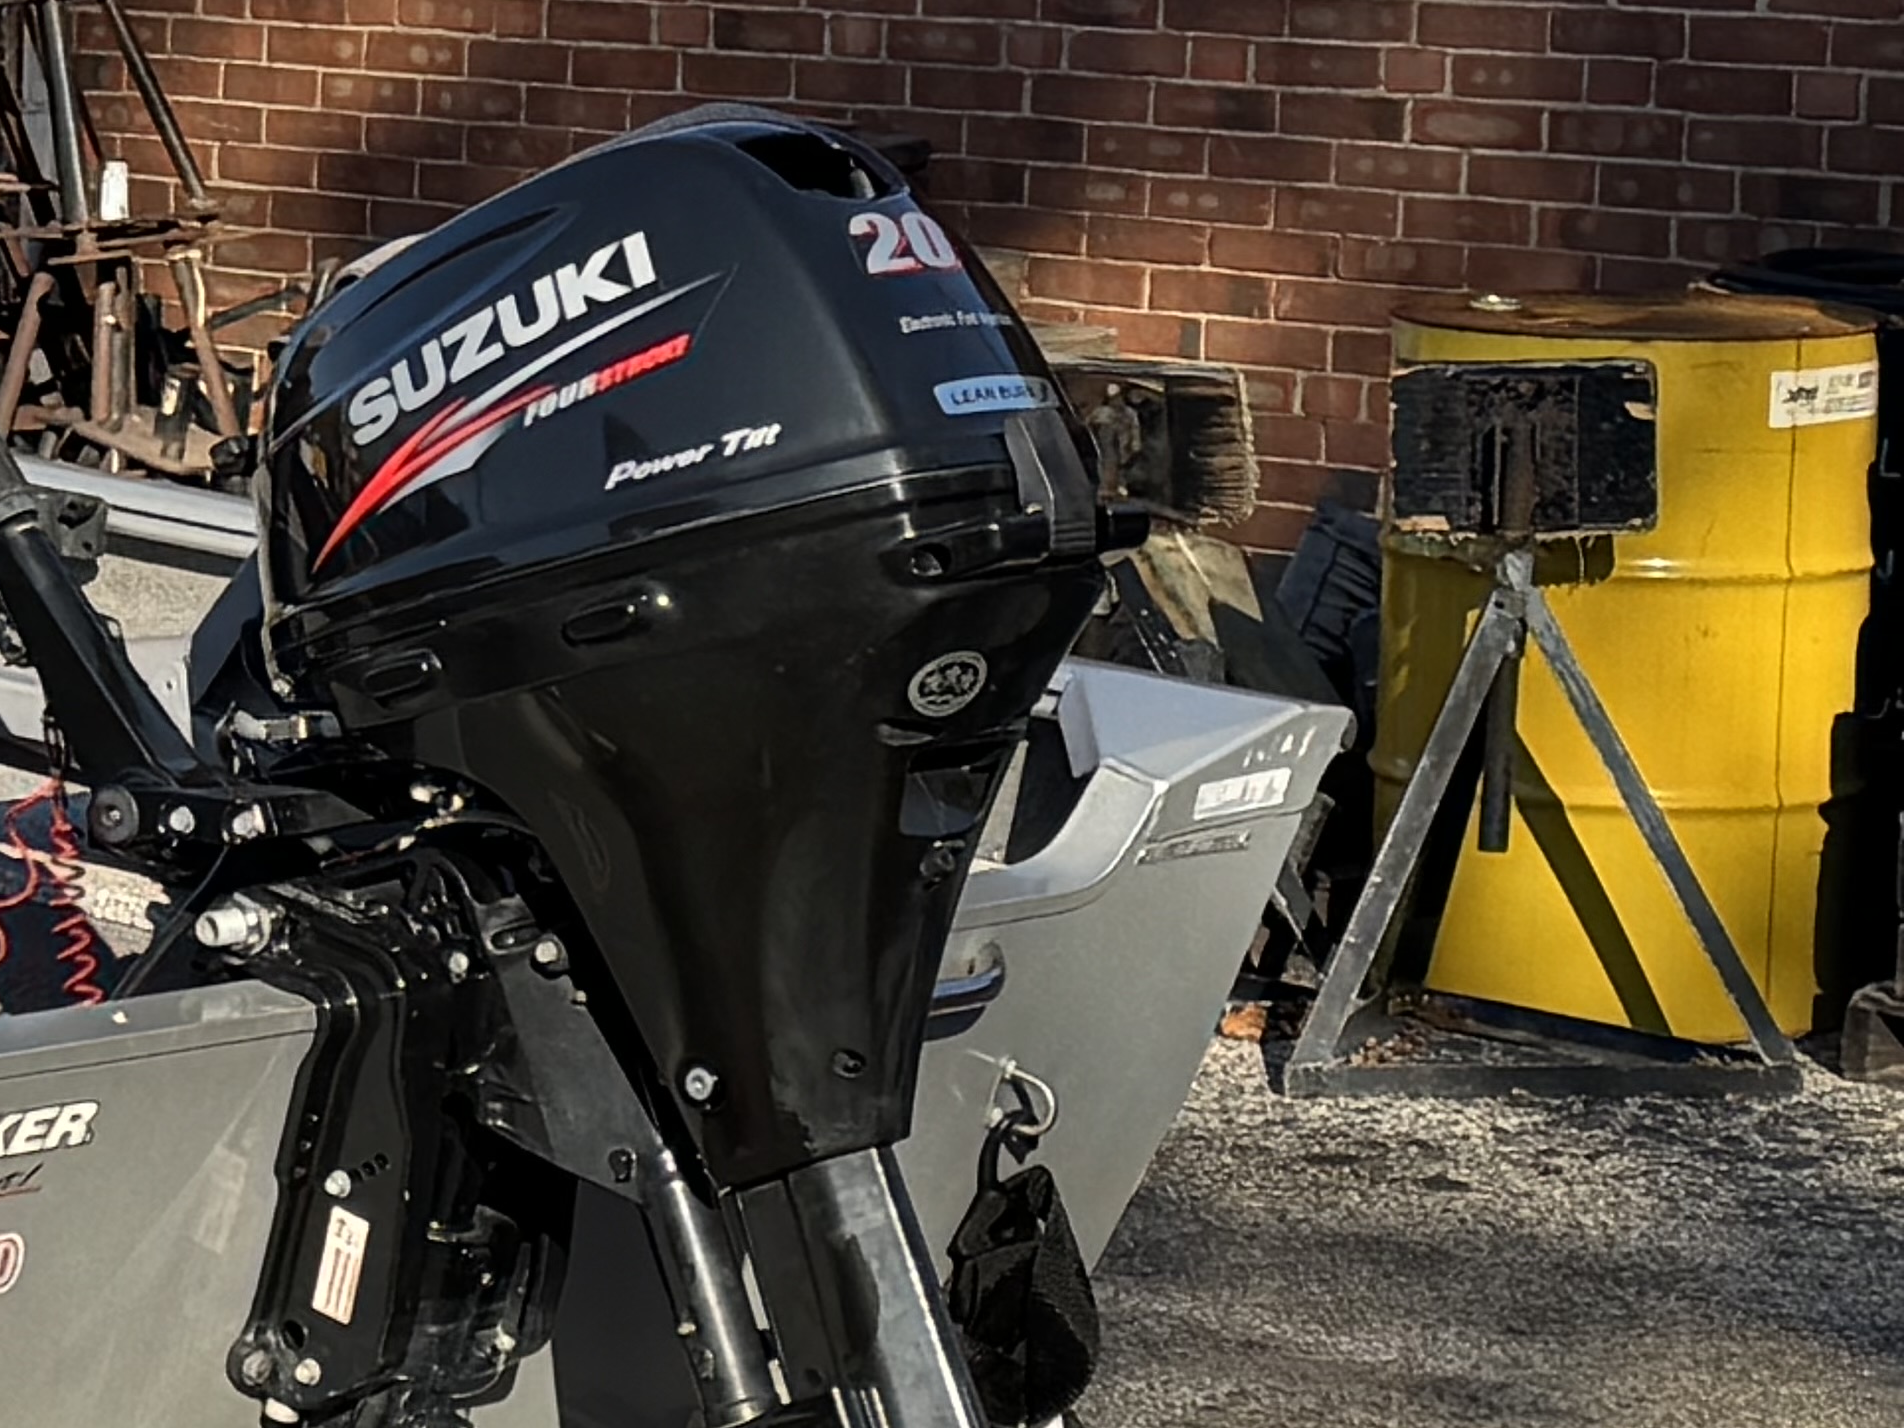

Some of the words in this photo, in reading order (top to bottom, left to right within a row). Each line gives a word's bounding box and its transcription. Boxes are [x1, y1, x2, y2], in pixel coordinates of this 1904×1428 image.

[848, 211, 962, 277] 20
[347, 230, 657, 448] SUZUKI
[604, 443, 715, 491] Power
[721, 422, 783, 457] Tilt
